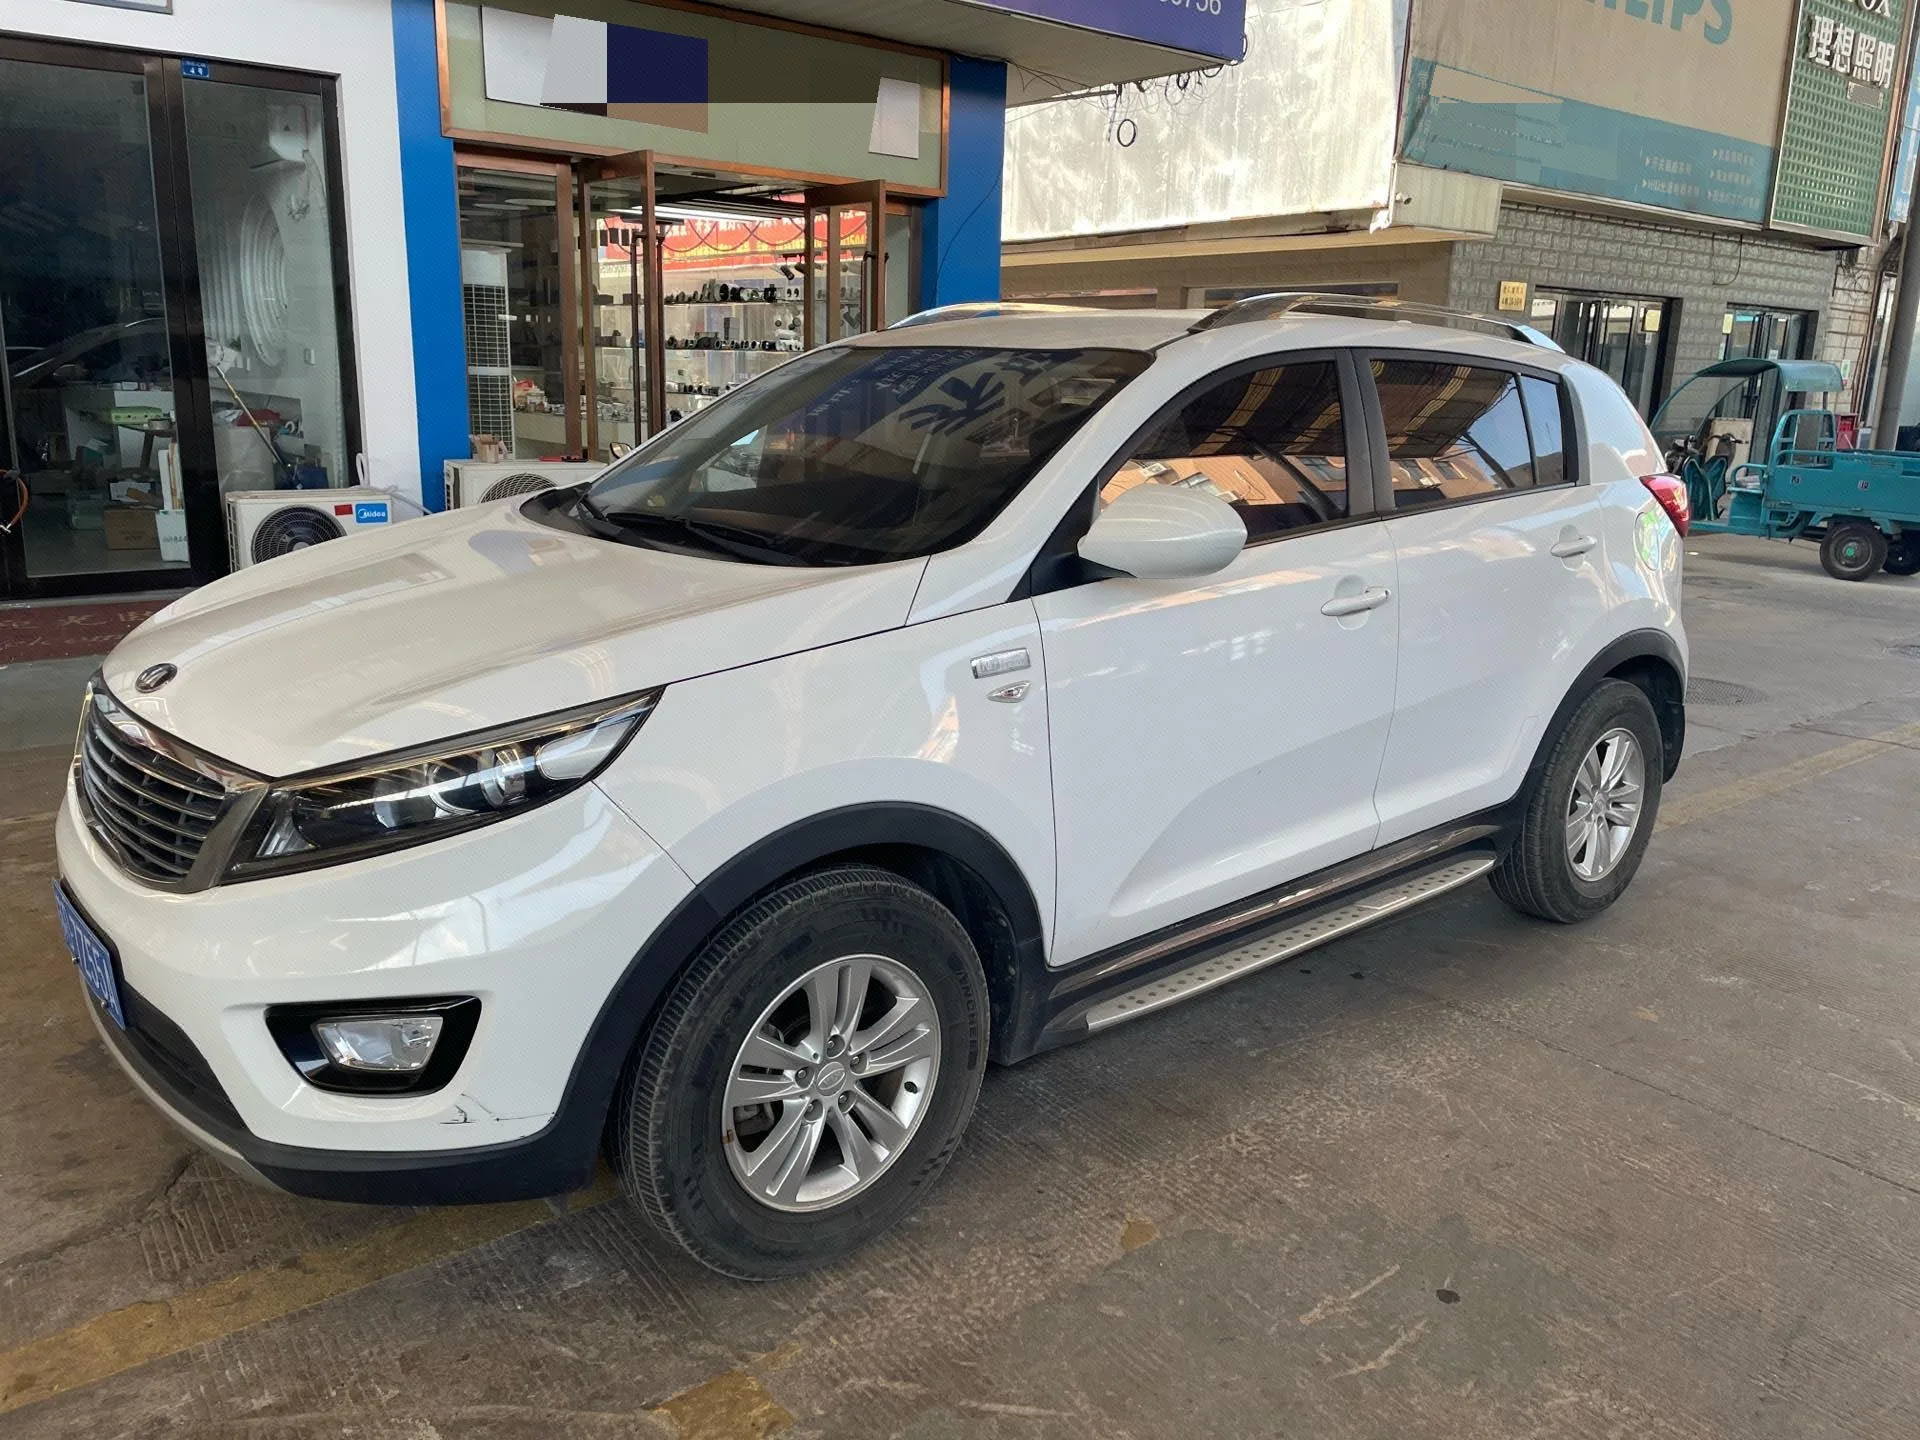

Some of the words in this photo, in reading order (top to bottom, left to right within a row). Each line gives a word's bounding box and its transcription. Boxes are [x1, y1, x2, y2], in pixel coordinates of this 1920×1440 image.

[1808, 15, 1896, 89] 理想照明
[362, 510, 386, 518] Midea
